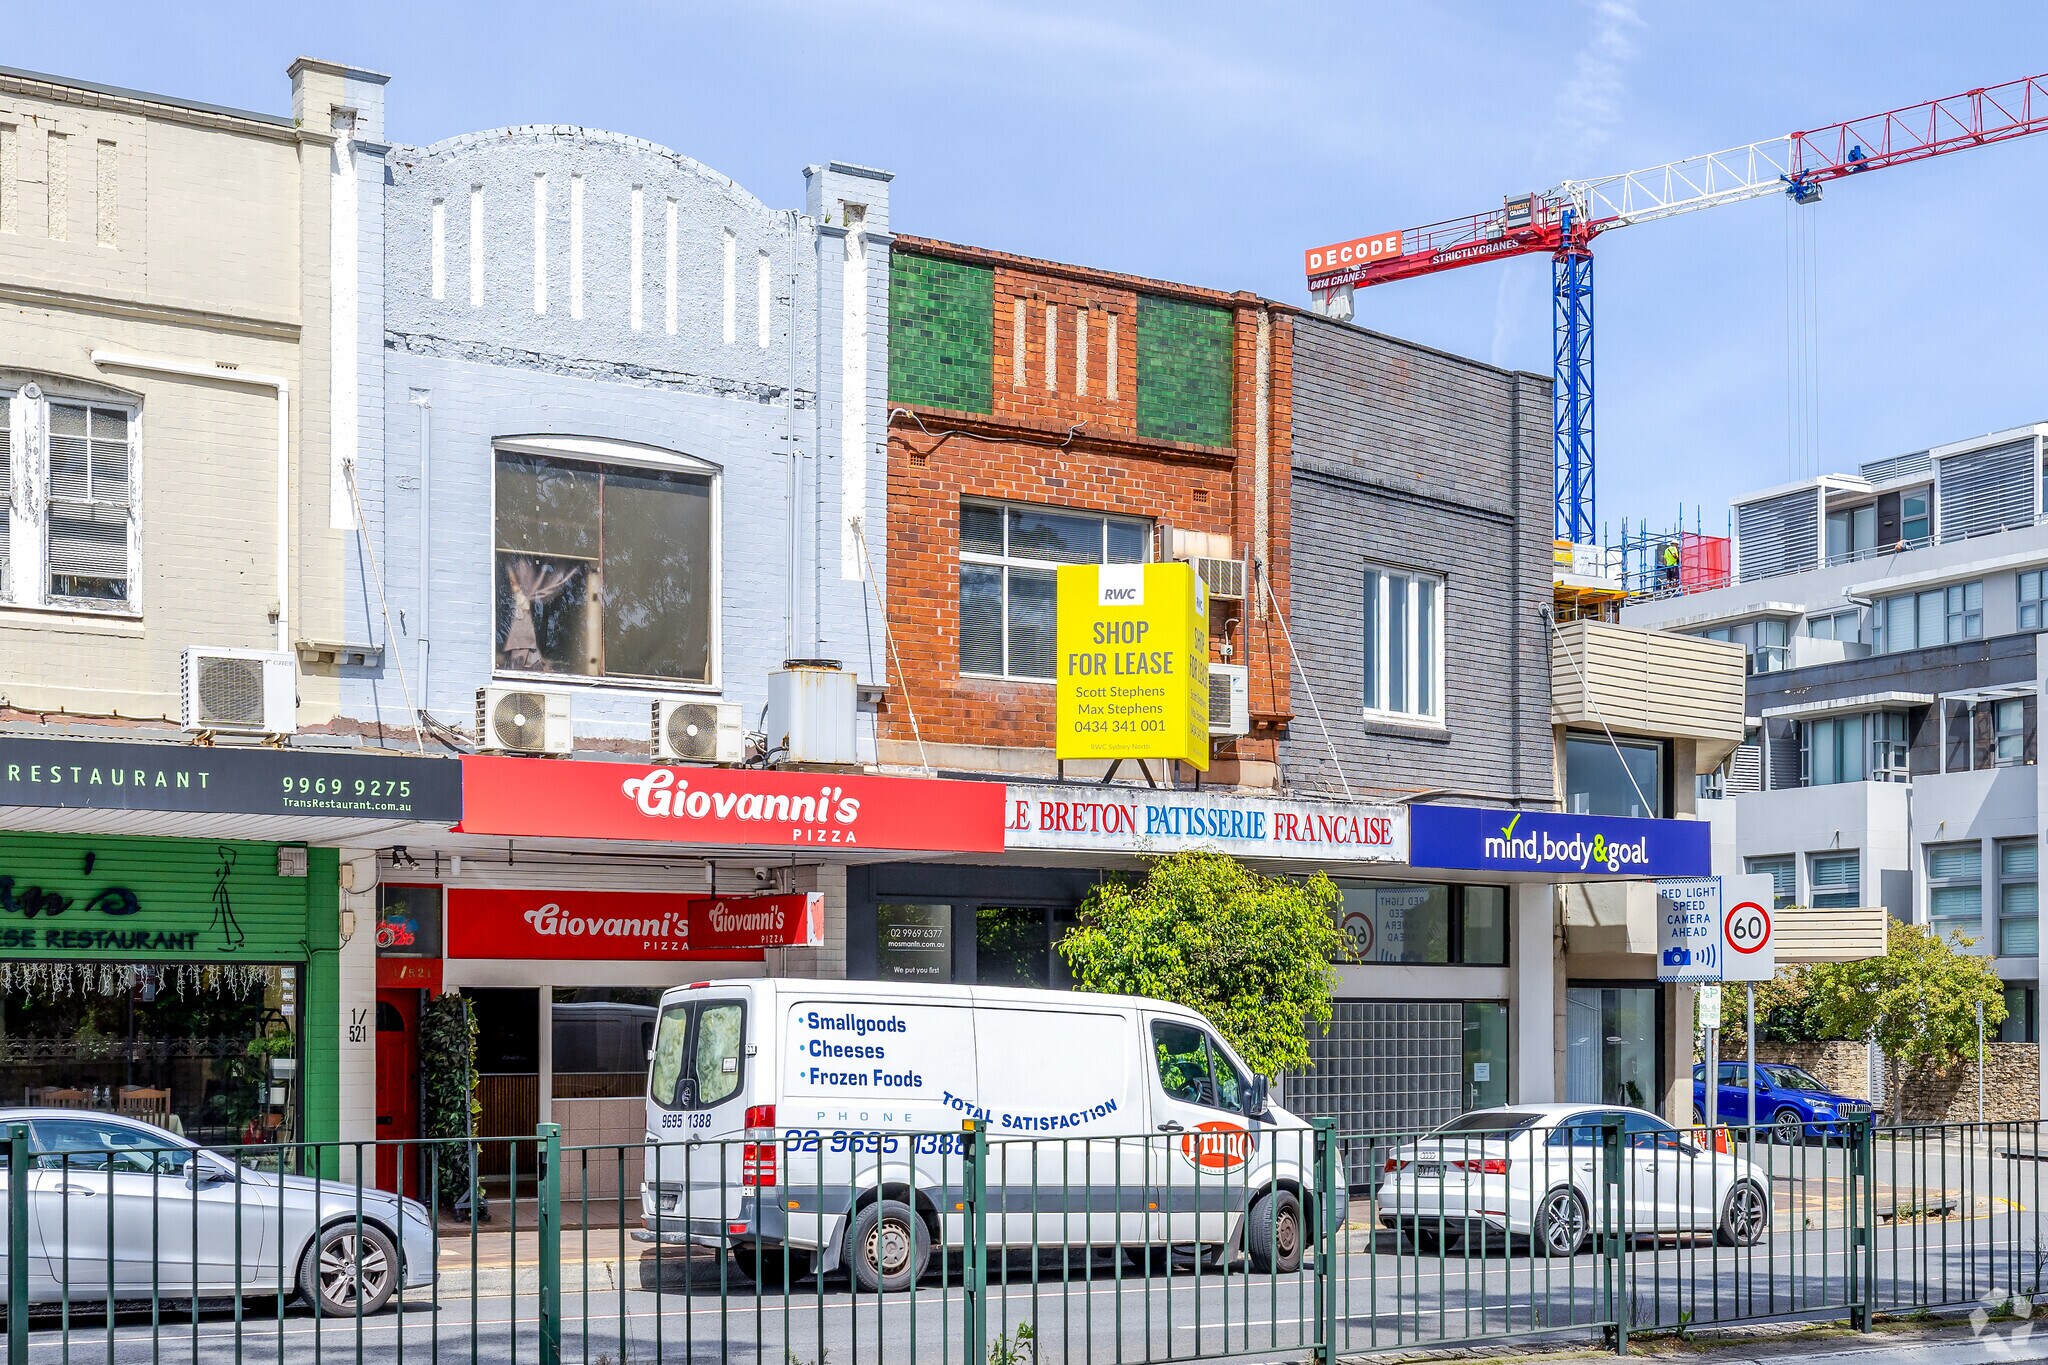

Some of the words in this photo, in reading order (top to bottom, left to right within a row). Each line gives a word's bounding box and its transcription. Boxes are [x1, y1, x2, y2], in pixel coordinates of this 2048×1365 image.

[1508, 202, 1530, 212] STRICTLY
[1510, 208, 1528, 217] CRANES
[1310, 236, 1396, 270] DECODE
[1311, 278, 1329, 290] 0414
[1331, 270, 1366, 286] CRANES
[1104, 588, 1136, 600] RWC
[1093, 620, 1150, 644] SHOP
[1068, 653, 1107, 676] FOR
[1115, 651, 1174, 675] LEASE
[1076, 687, 1107, 698] Scott
[1110, 685, 1165, 700] Stephens
[1078, 704, 1104, 715] Max
[1108, 702, 1163, 717] Stephens
[1074, 720, 1110, 733] 0434
[1112, 720, 1137, 732] 341
[1140, 719, 1166, 732] 001
[1108, 743, 1130, 752] Sydney
[1132, 742, 1150, 750] North
[8, 764, 210, 790] RESTAURANT
[282, 776, 342, 795] 9969
[354, 779, 411, 798] 9275
[282, 797, 412, 812] TransRestaurant.com.au
[622, 768, 861, 826] Giovanni's
[1039, 801, 1138, 835] BRETON
[1145, 805, 1266, 840] PATISSERIE
[1274, 812, 1394, 846] FRANCAISE
[792, 828, 857, 843] PIZZA
[1662, 888, 1682, 899] RED
[1686, 886, 1716, 898] LIGHT
[1673, 900, 1706, 912] SPEED
[523, 902, 689, 937] Giovanni's
[708, 901, 785, 933] Giovanni's
[1667, 914, 1711, 925] CAMERA
[890, 928, 901, 938] 02
[902, 928, 922, 938] 9969
[924, 930, 943, 938] 6377
[1672, 926, 1708, 938] AHEAD
[1734, 916, 1762, 940] 60
[46, 930, 199, 950] RESTAURANT
[643, 942, 689, 951] PIZZA
[760, 934, 784, 944] PIZZA
[928, 966, 940, 974] first
[807, 1012, 906, 1036] Smallgoods
[349, 1025, 366, 1042] 521
[809, 1039, 885, 1059] Cheeses
[810, 1067, 868, 1086] Frozen
[873, 1068, 922, 1088] Foods
[817, 1111, 912, 1123] PHONE
[942, 1090, 994, 1124] TOTAL
[1001, 1098, 1118, 1131] SATISFACTION
[661, 1114, 683, 1129] 9695
[687, 1114, 712, 1128] 1388
[784, 1129, 820, 1153] 02
[830, 1130, 899, 1154] 9695
